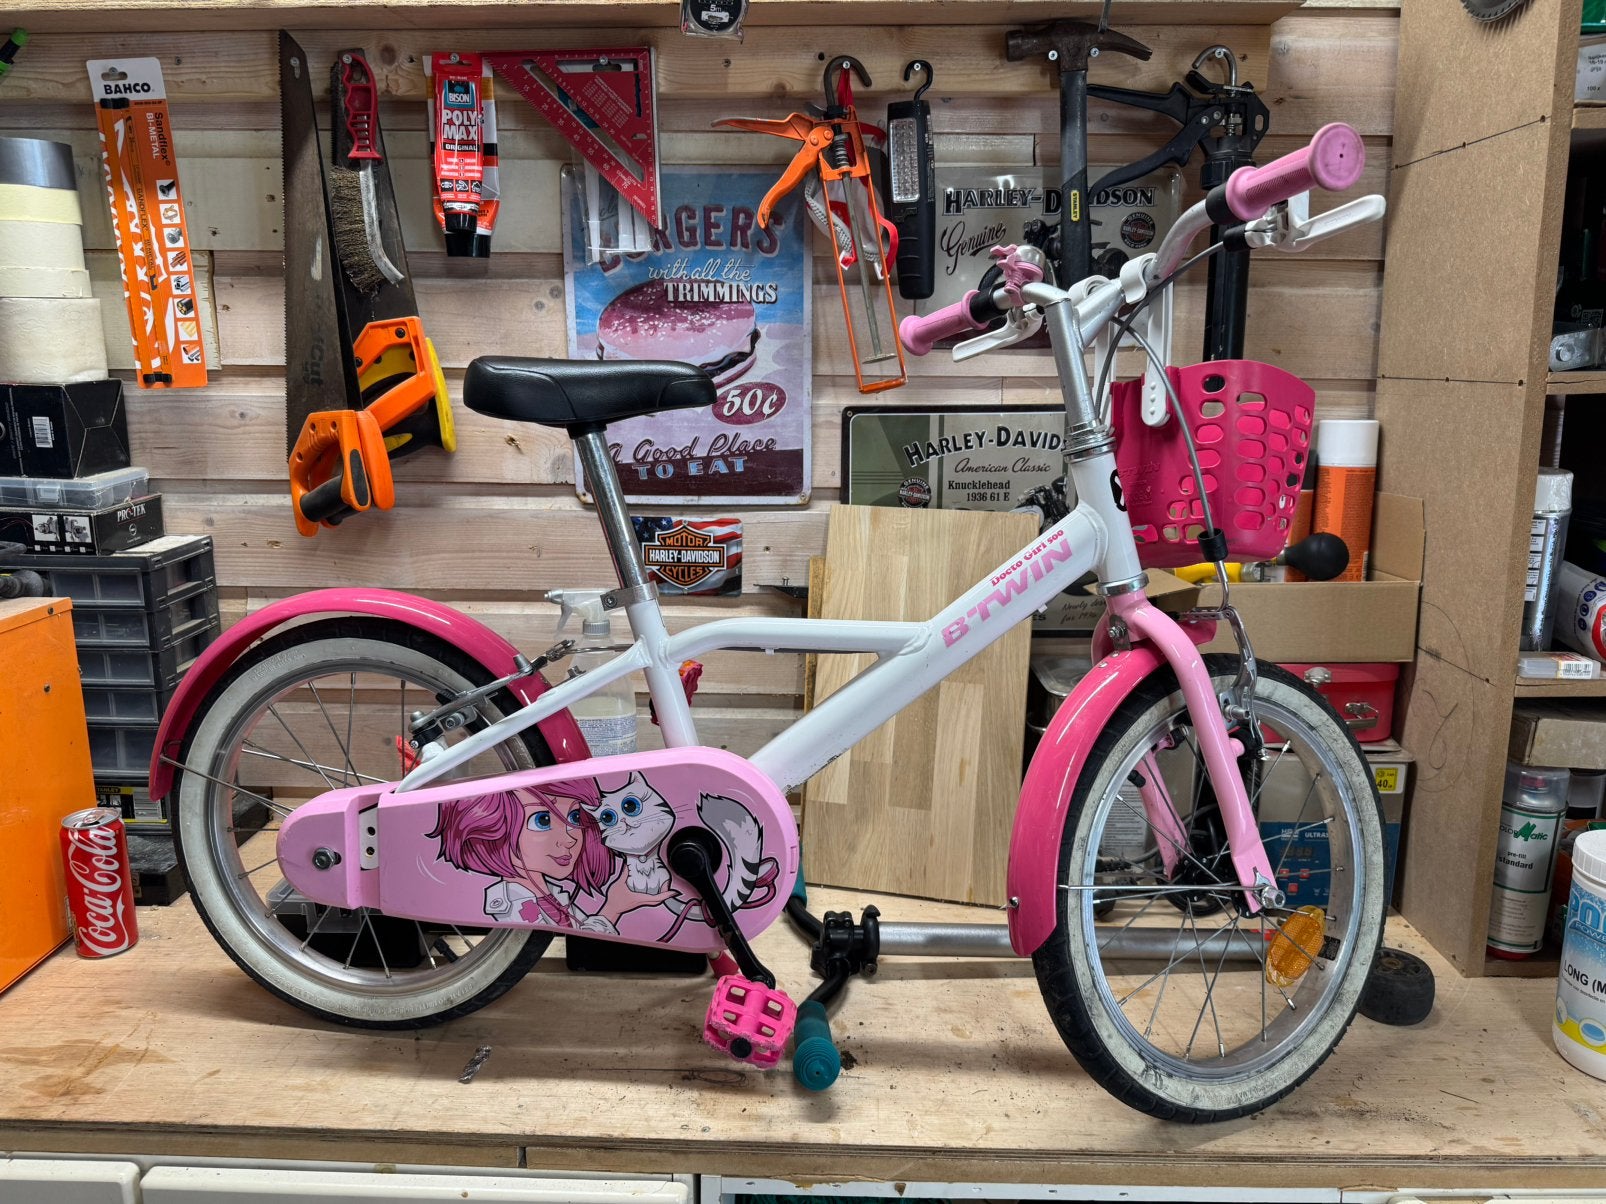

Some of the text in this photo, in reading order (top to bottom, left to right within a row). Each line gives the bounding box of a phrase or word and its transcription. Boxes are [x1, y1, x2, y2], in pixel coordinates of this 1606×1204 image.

[103, 82, 151, 95] BAHCO
[448, 93, 470, 103] BISON
[442, 109, 478, 126] POLY
[146, 112, 160, 160] BI-METAL
[443, 124, 478, 141] MAX
[942, 186, 1158, 217] HARLEY-DDSON
[1071, 191, 1079, 221] STANLEY
[940, 220, 1007, 276] Genuine
[648, 257, 755, 281] with all the
[663, 281, 778, 305] TRIMMINGS
[632, 435, 701, 463] Good
[706, 431, 778, 458] Place
[631, 455, 748, 480] TO EAT
[953, 456, 1052, 474] American Classic
[947, 480, 1011, 491] Knucklehead
[966, 492, 1010, 502] 1936 61 E
[665, 533, 703, 547] MOTOR
[649, 549, 720, 564] HARLEY-DAVIDSON
[990, 529, 1065, 587] Docto Girl 500
[665, 566, 703, 581] CYCLES
[1498, 856, 1534, 870] standard
[1507, 851, 1527, 859] pre-fill
[68, 826, 125, 956] Coca-Cola
[1564, 959, 1589, 986] LONG
